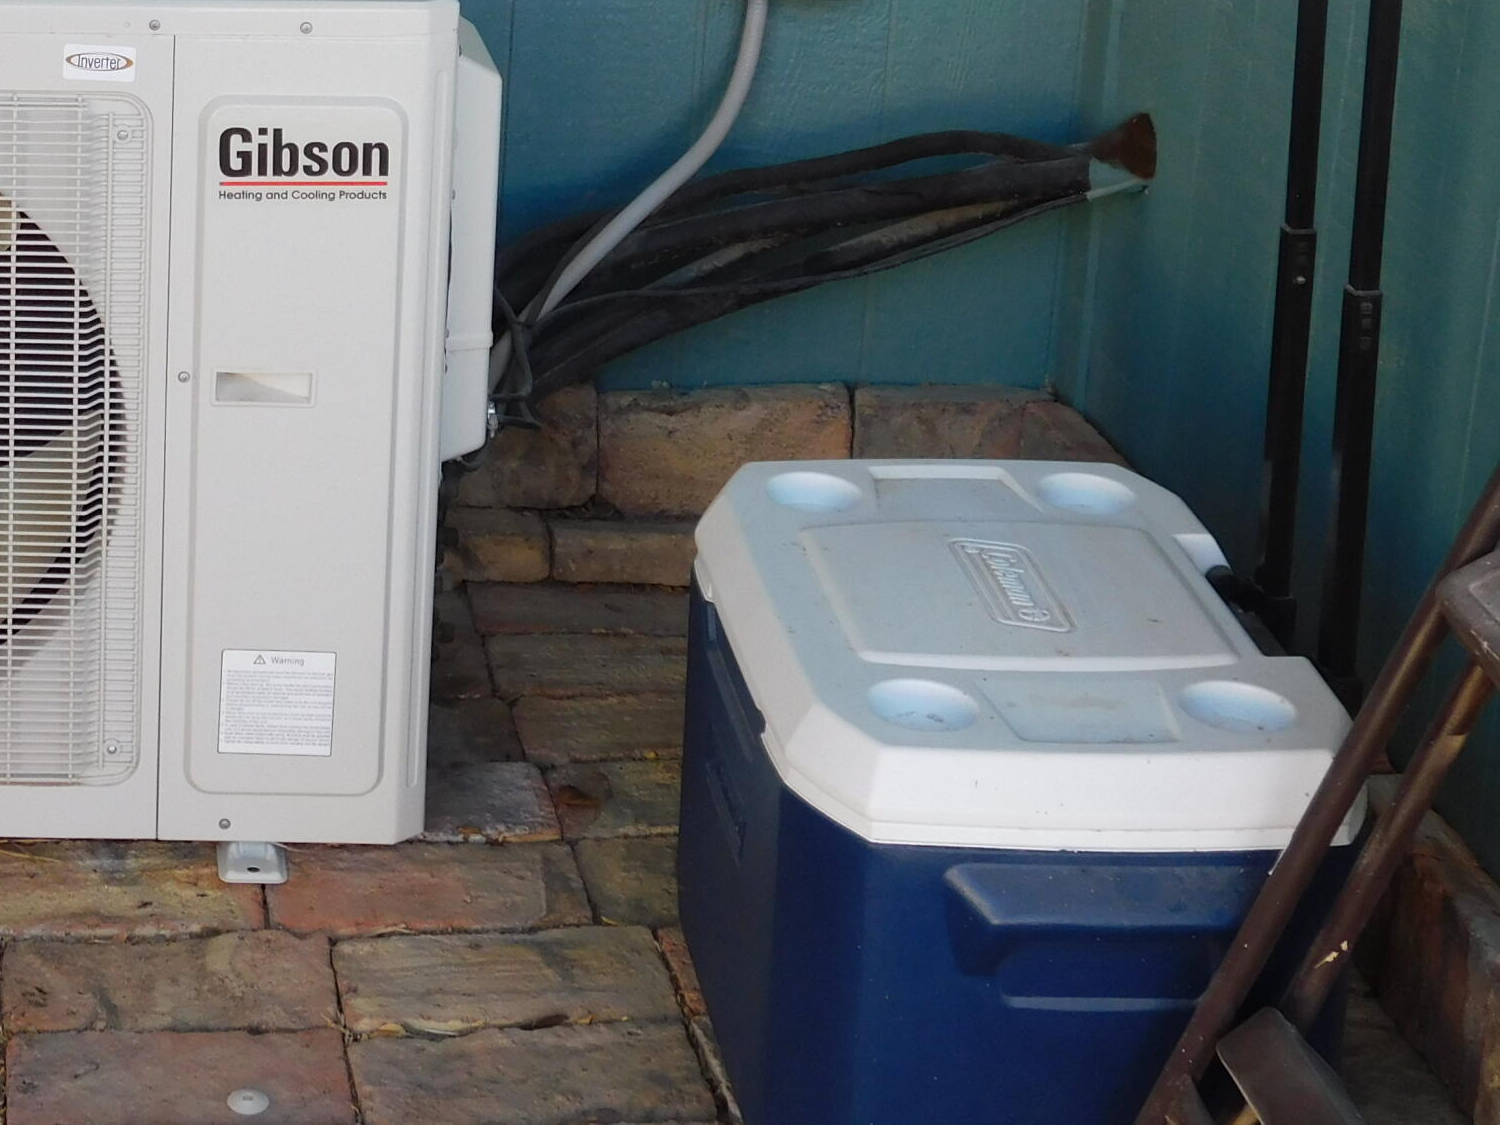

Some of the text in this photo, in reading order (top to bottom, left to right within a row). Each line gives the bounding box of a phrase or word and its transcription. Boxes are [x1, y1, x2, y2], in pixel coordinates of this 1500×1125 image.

[77, 54, 122, 70] Inverter
[218, 126, 389, 178] Gibson
[218, 190, 388, 202] Heating and Cooling Products
[270, 656, 305, 667] Warning
